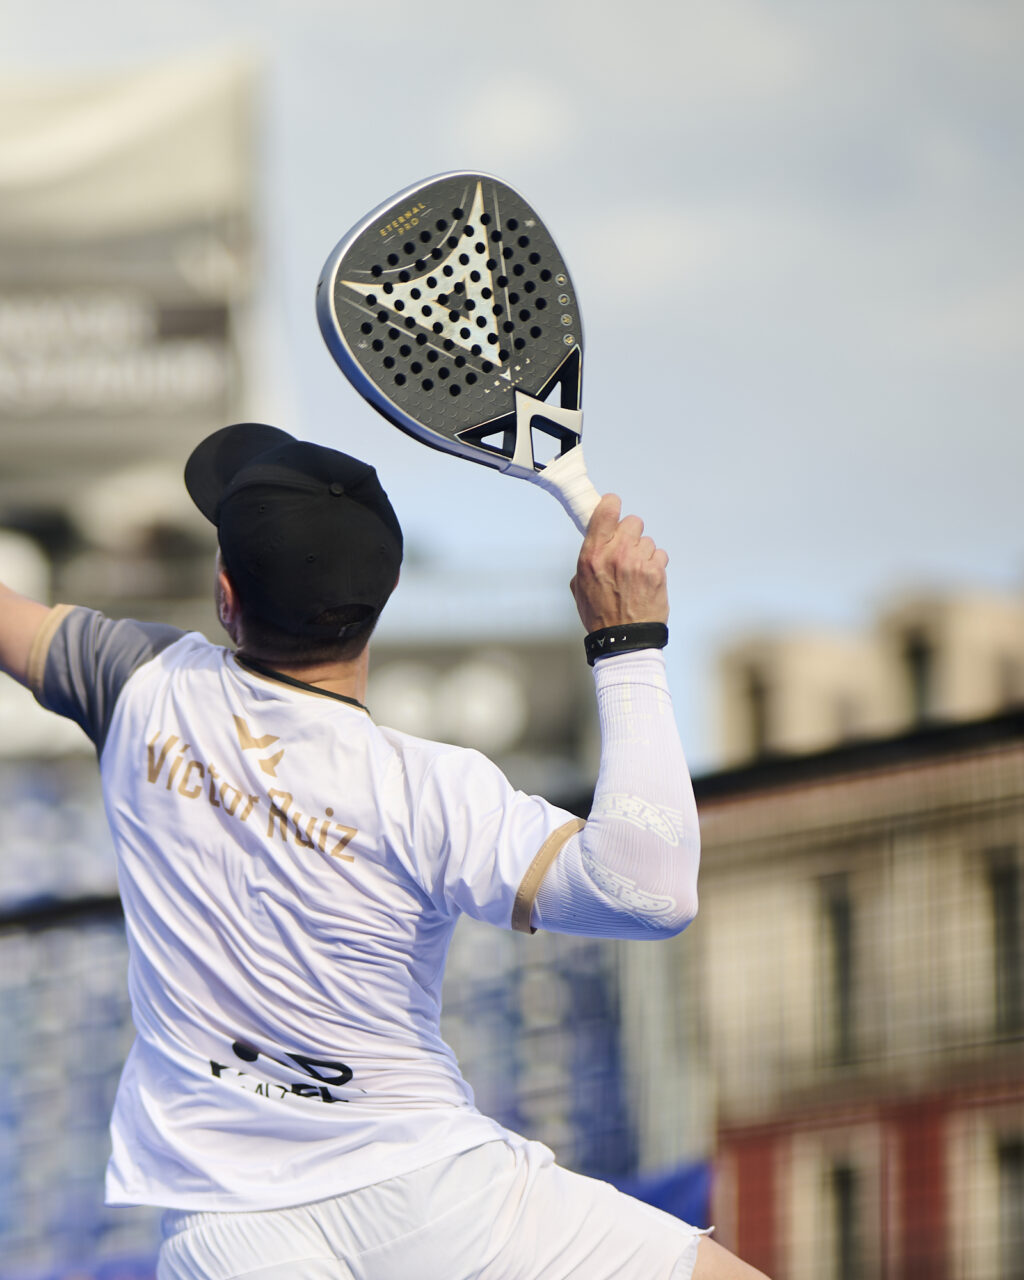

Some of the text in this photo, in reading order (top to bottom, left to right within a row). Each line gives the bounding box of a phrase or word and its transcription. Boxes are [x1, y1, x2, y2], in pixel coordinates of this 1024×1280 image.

[379, 202, 426, 237] ETERNAL
[397, 217, 420, 236] PRO
[267, 787, 359, 863] Ruiz
